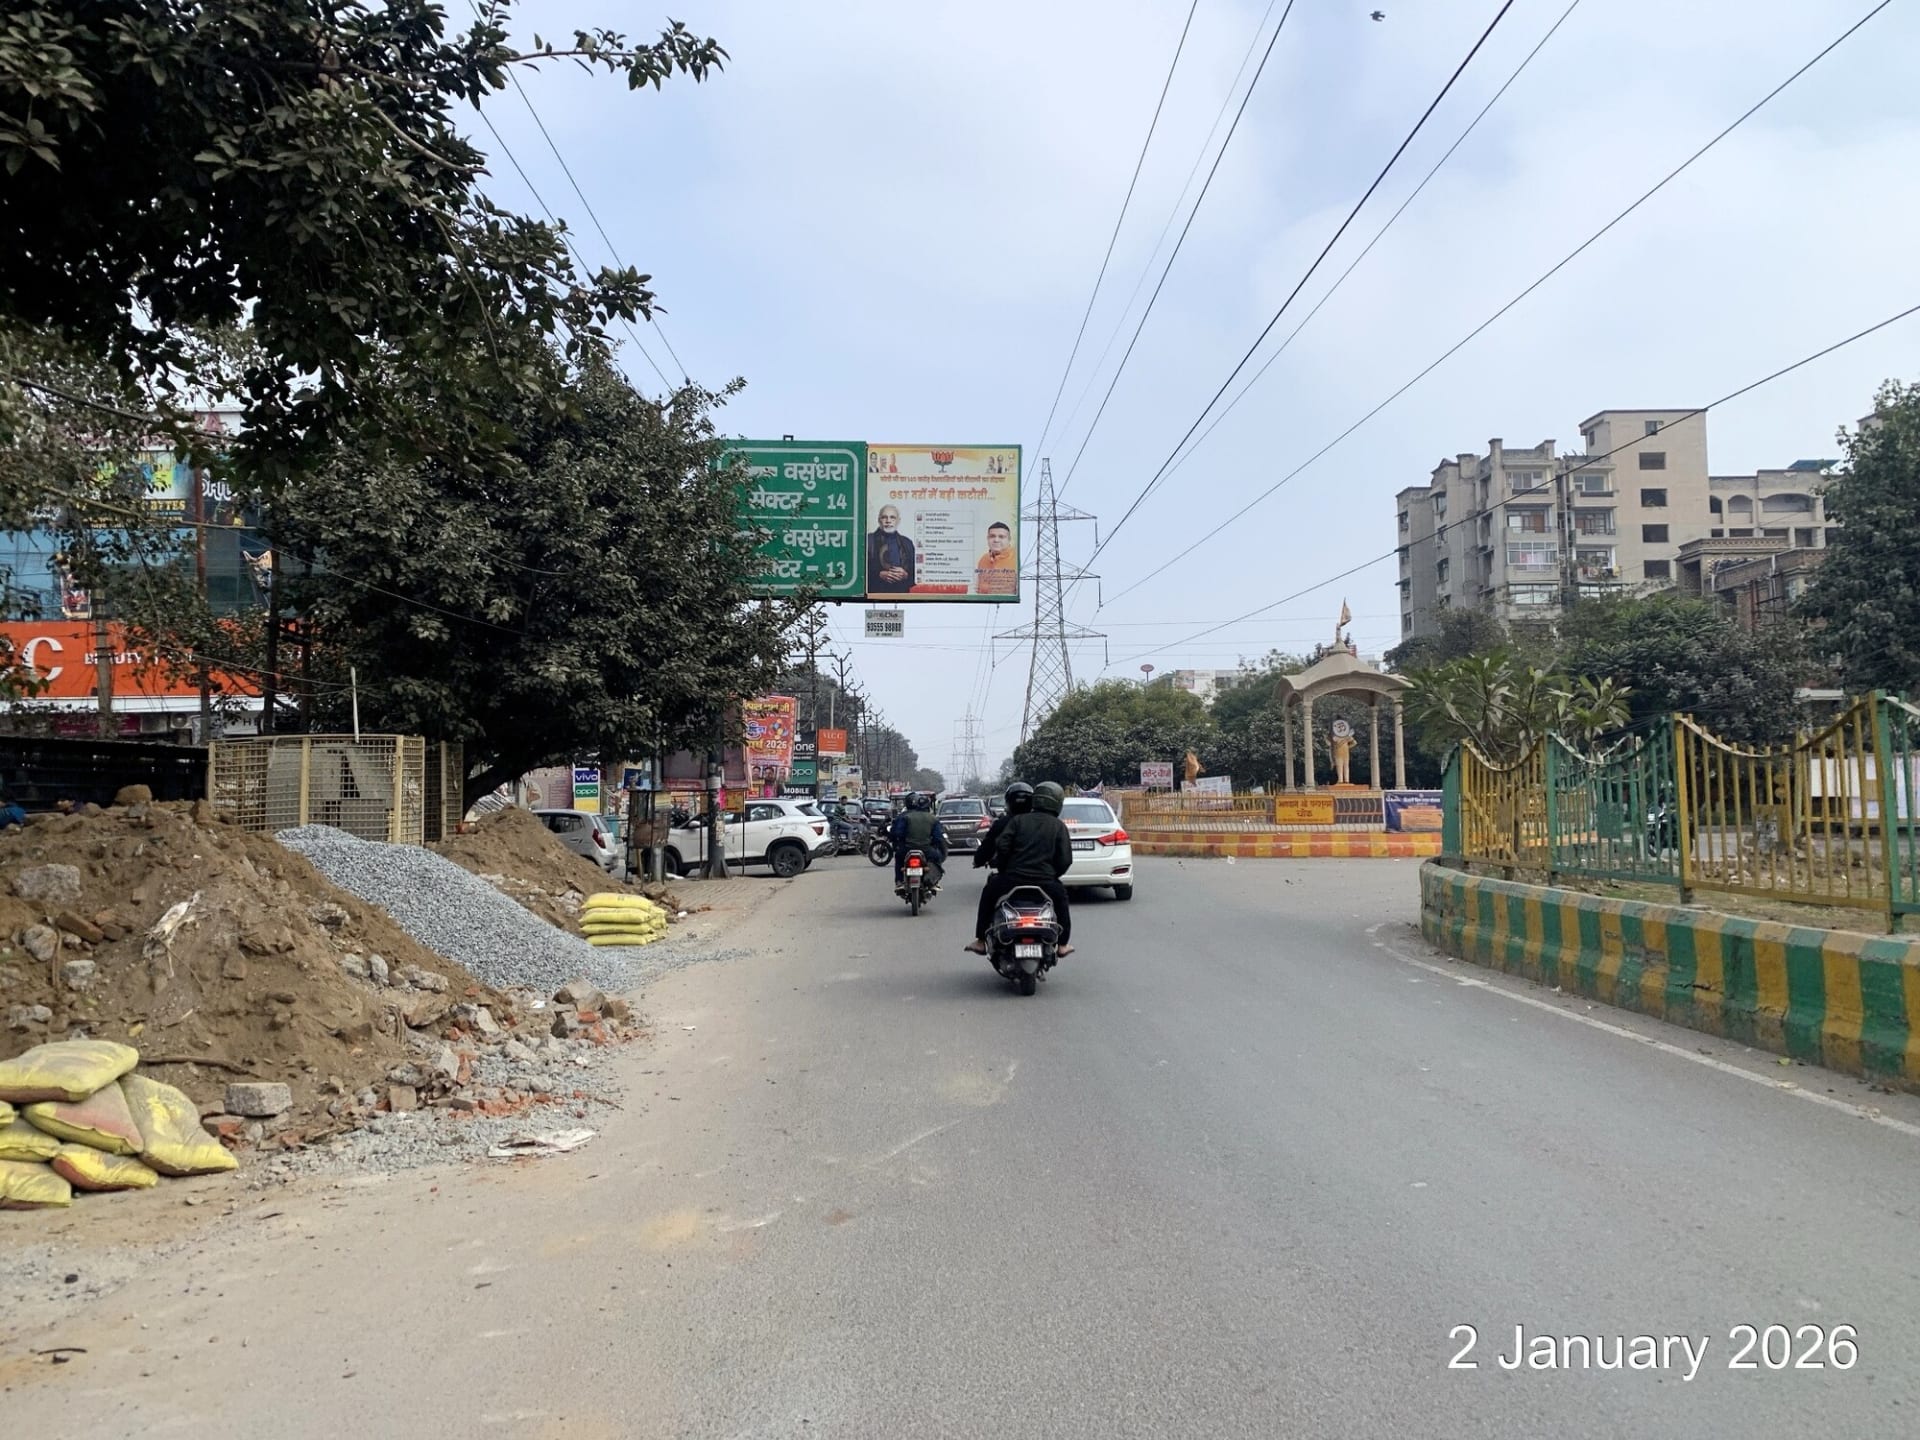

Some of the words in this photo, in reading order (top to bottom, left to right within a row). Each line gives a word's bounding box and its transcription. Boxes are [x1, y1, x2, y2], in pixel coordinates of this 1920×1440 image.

[784, 456, 848, 490] वसुंधरा
[889, 490, 909, 499] GST
[826, 493, 848, 510] 14
[783, 523, 848, 557] वसुंधरा
[826, 561, 846, 578] 13
[765, 740, 788, 750] 2026
[575, 773, 599, 781] vivo
[575, 787, 598, 795] oppo
[783, 787, 810, 795] MOBILE
